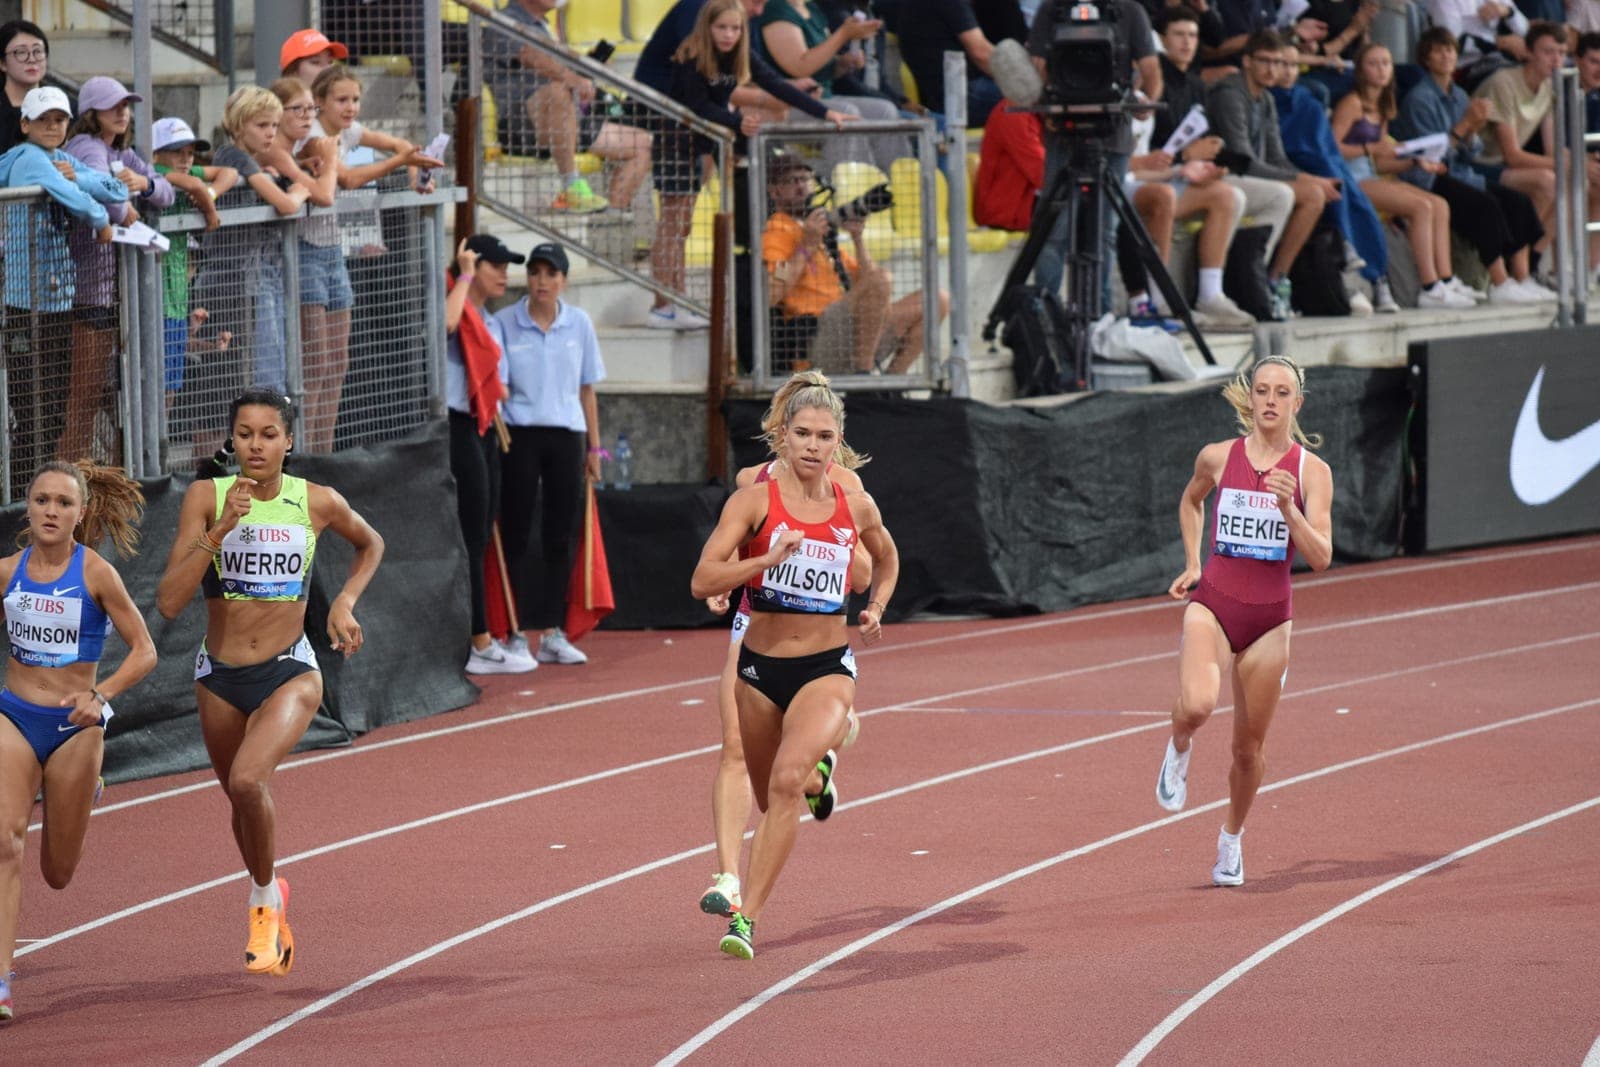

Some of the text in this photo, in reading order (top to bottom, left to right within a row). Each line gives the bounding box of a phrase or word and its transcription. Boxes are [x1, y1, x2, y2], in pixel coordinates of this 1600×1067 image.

[1248, 494, 1278, 510] UBS
[259, 529, 290, 543] UBS
[1219, 513, 1287, 541] REEKIE
[806, 543, 837, 562] UBS
[223, 551, 302, 576] WERRO
[767, 560, 843, 596] WILSON
[244, 583, 288, 594] LAUSANNE
[34, 598, 65, 615] UBS
[782, 594, 827, 609] LAUSANNE
[9, 620, 78, 644] JOHNSON
